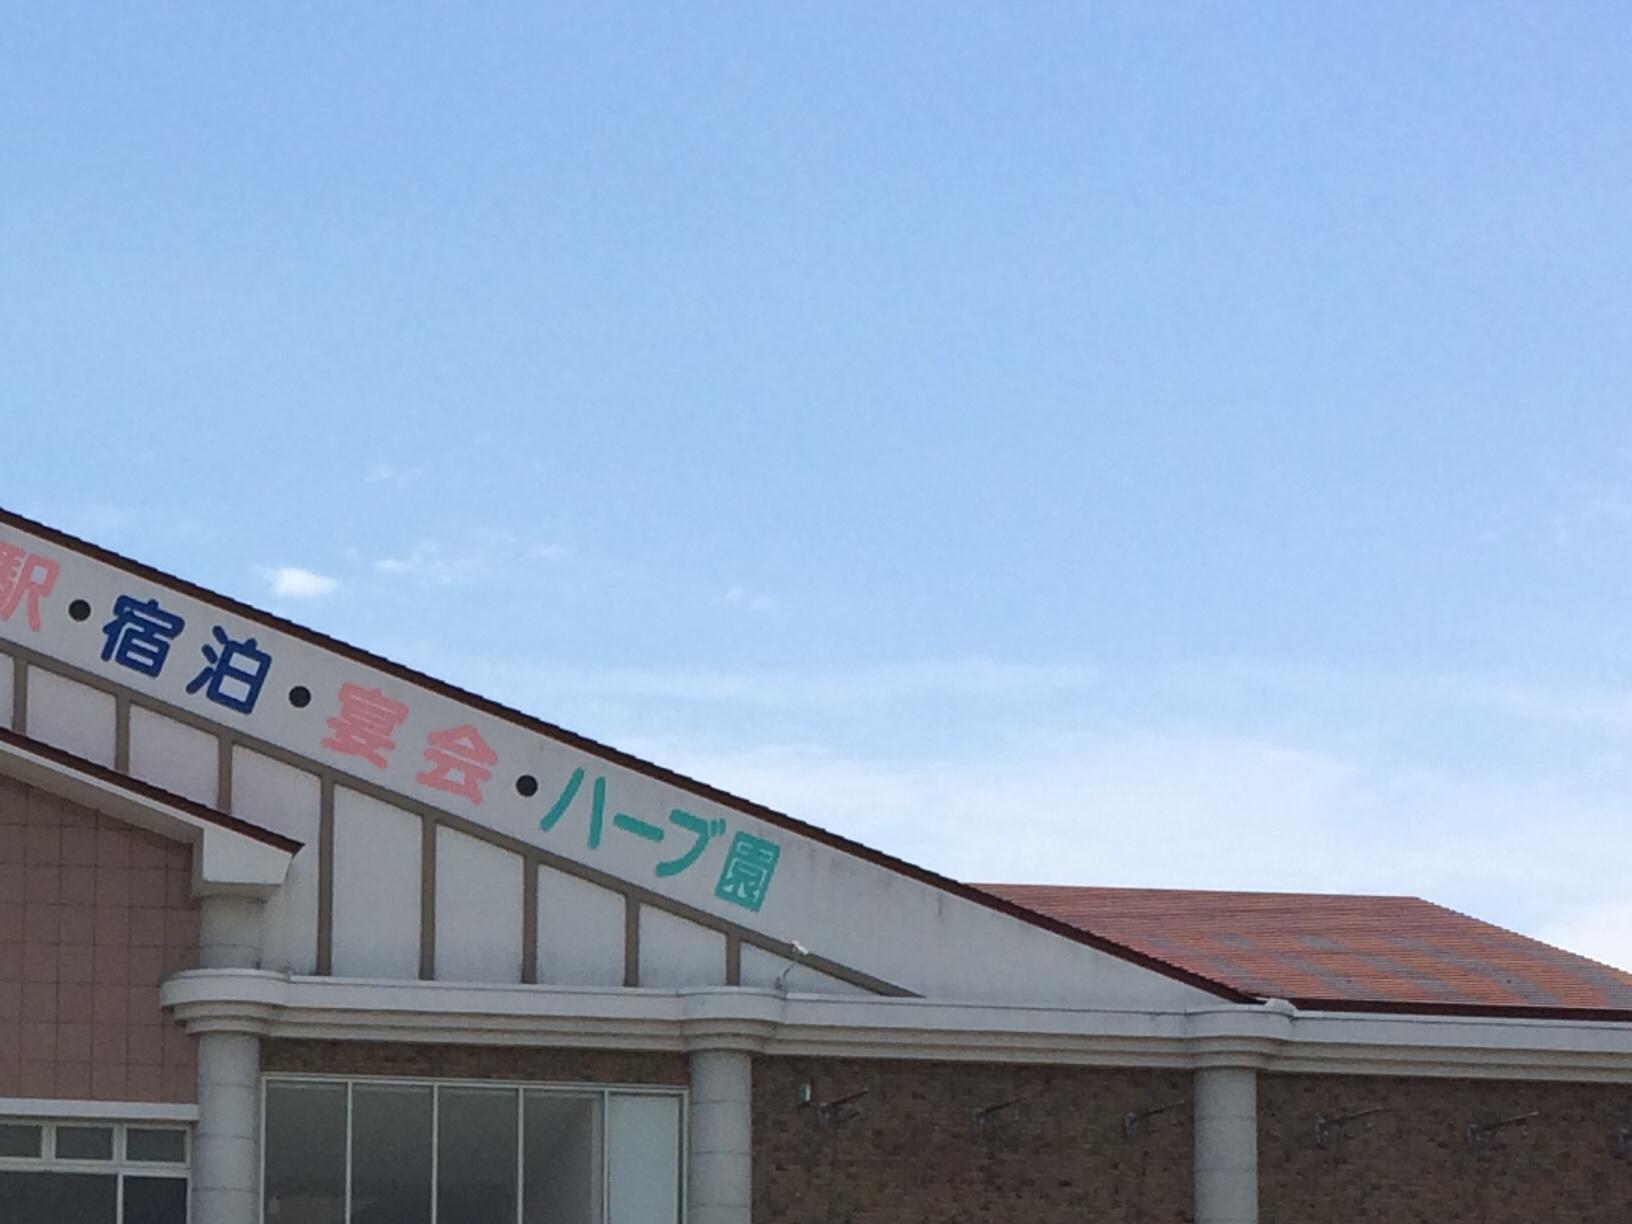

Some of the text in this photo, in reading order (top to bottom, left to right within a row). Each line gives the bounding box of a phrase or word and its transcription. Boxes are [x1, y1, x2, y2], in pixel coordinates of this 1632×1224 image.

[101, 593, 273, 715] 宿泊
[321, 681, 499, 805] 宴会
[539, 767, 782, 914] ハーブ園
